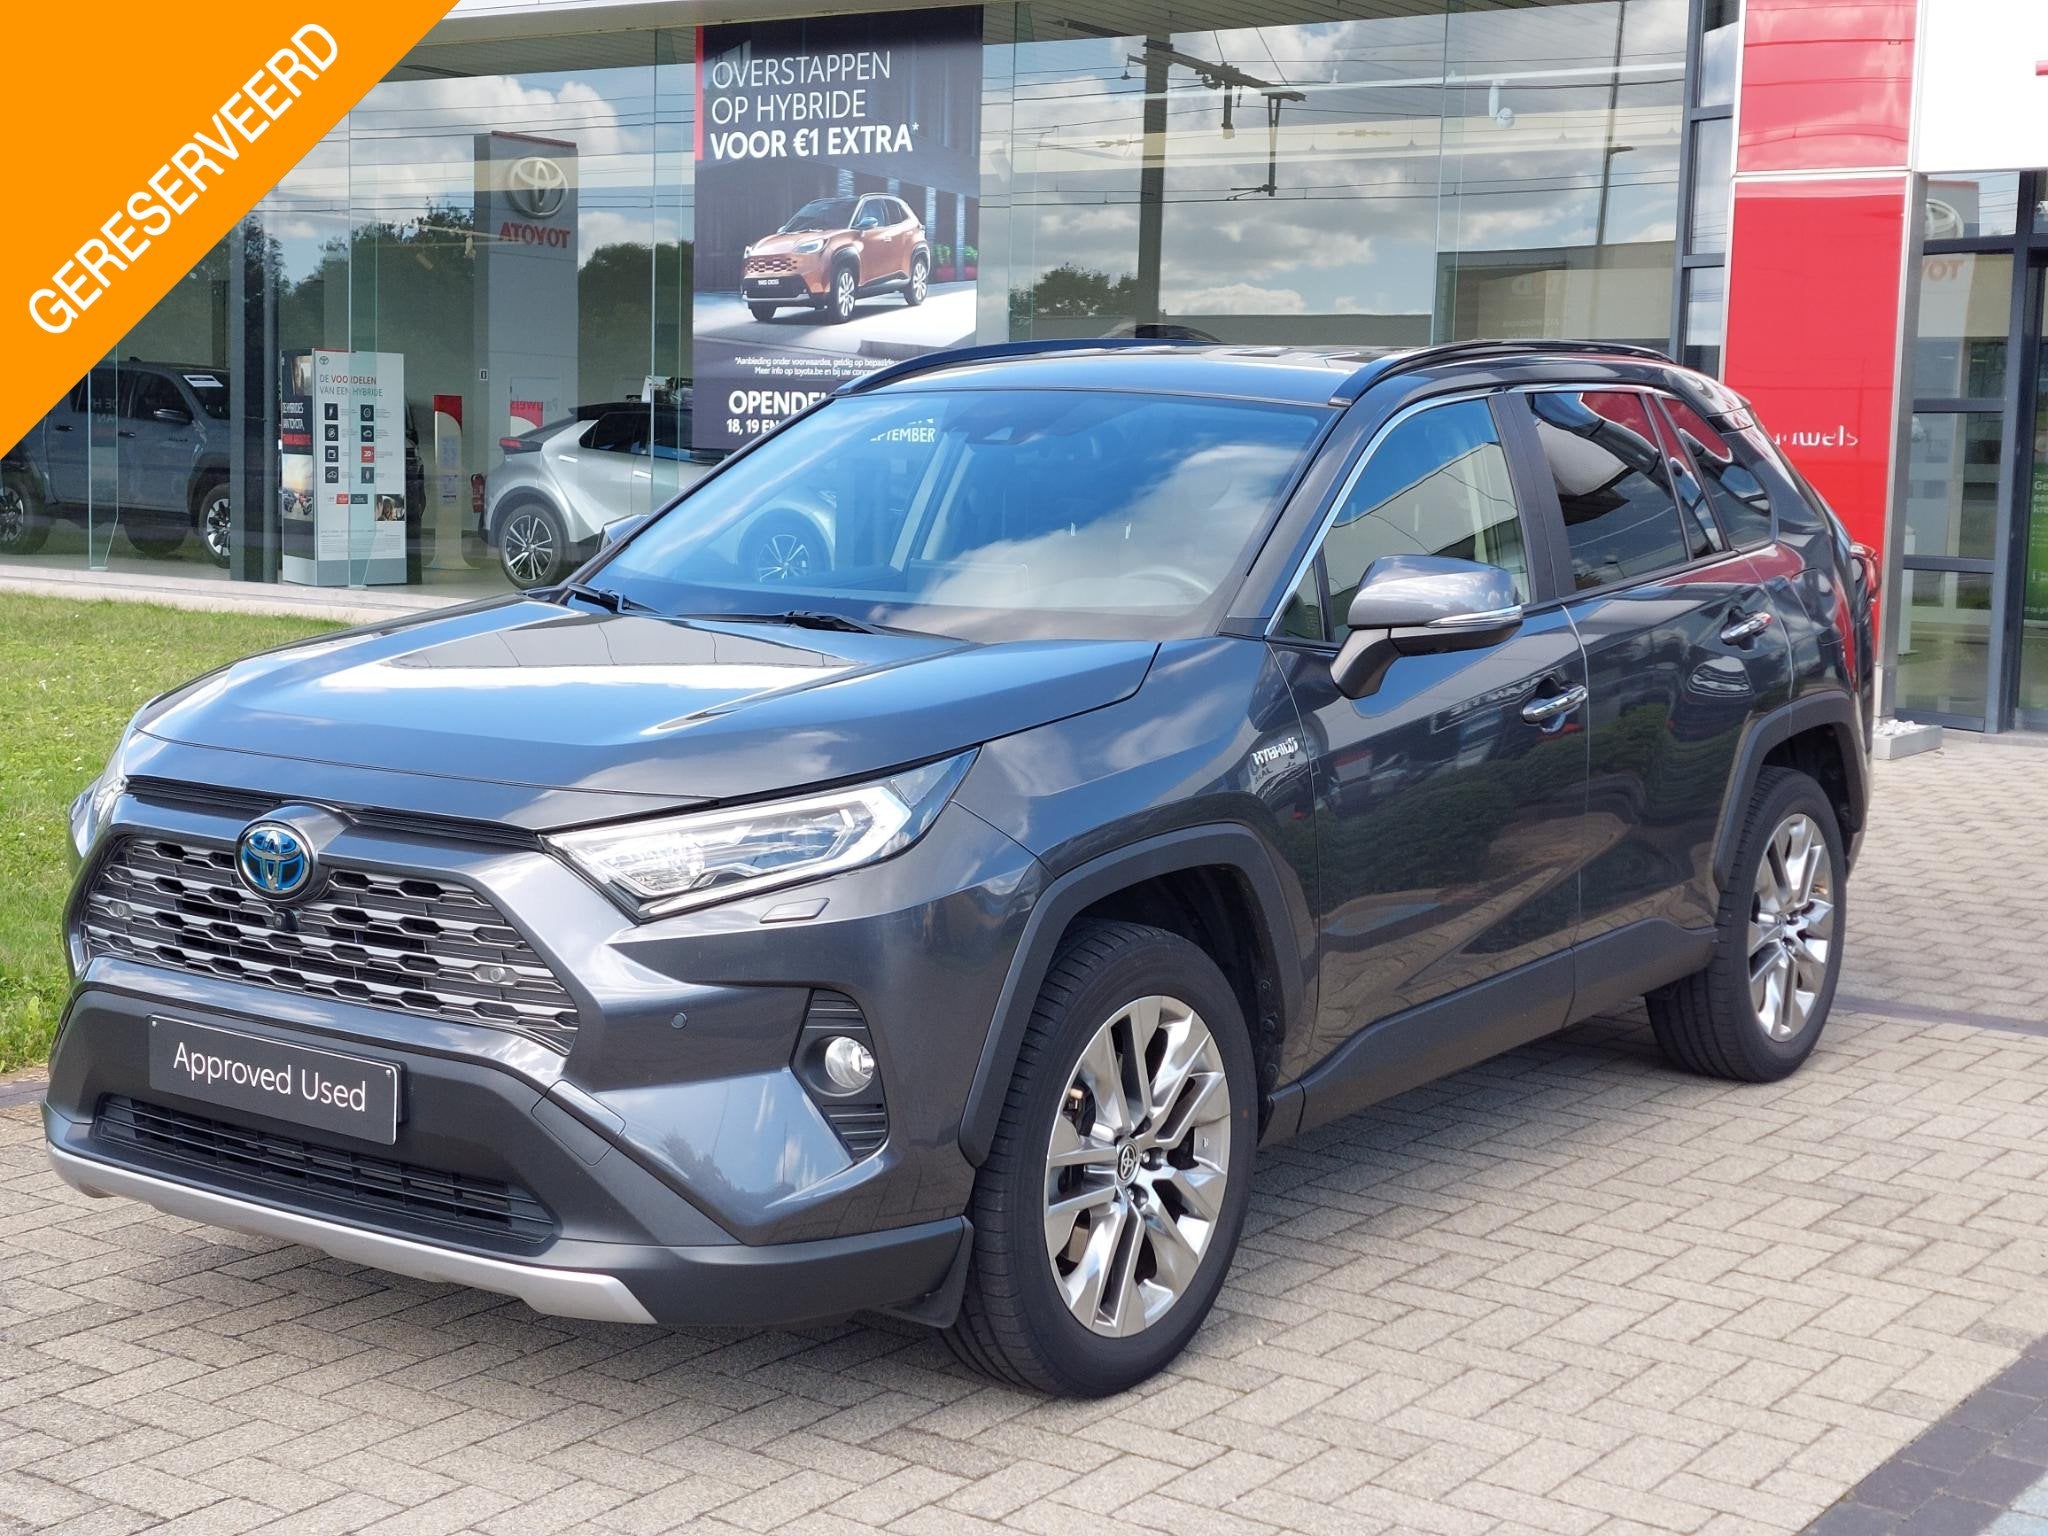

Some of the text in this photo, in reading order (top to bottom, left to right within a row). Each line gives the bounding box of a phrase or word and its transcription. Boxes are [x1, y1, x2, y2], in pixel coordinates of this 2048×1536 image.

[712, 50, 891, 89] OVERSTAPPEN
[711, 89, 866, 125] OP HYBRIDE
[710, 130, 788, 160] VOOR
[793, 127, 819, 157] €1
[726, 418, 744, 436] 18,
[746, 418, 760, 434] 19
[173, 1041, 366, 1112] Approved Used
